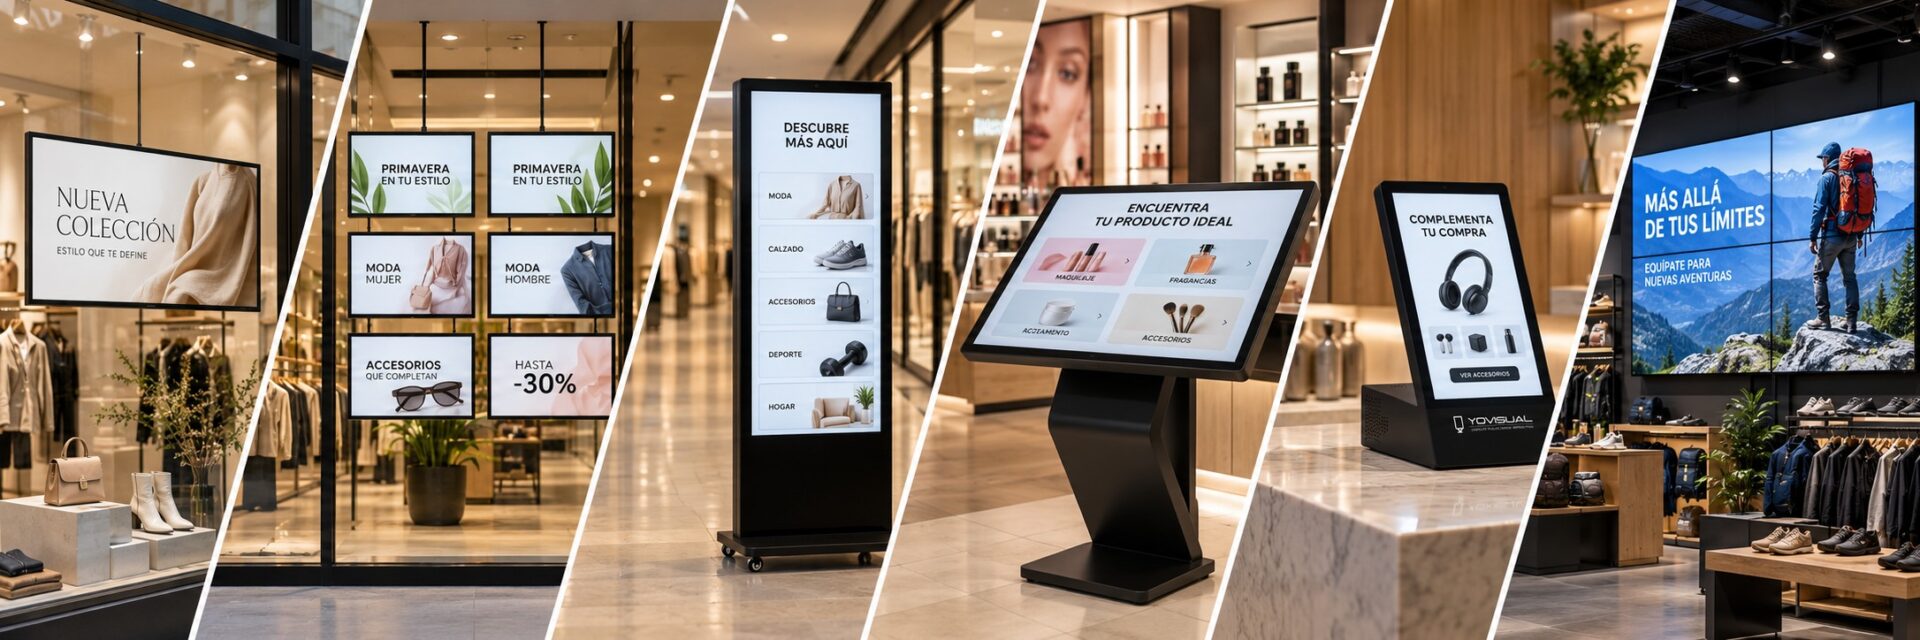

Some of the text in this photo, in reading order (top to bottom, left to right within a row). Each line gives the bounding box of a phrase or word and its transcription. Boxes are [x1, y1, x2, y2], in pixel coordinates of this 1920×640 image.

[783, 122, 850, 134] DESCUBRE
[785, 135, 848, 149] MÁS AQUÍ
[381, 163, 450, 174] PRIMAVERA
[513, 163, 582, 174] PRIMAVERA
[381, 176, 451, 186] EN TU ESTILO
[513, 176, 582, 186] EN TU ESTILO
[57, 186, 129, 213] NUEVA
[768, 192, 792, 200] MODA
[1645, 179, 1722, 213] MÁS ALLÁ
[1126, 202, 1210, 214] ENCUENTRA
[1095, 216, 1233, 227] TU PRODUCTO IDEAL
[1409, 214, 1494, 225] COMPLEMENTA
[1645, 205, 1765, 239] DE TUS LÍMITES
[56, 214, 175, 243] COLECCIÓN
[1421, 227, 1487, 238] TU COMPRA
[56, 246, 148, 260] ESTILO QUE TE DEFINE
[768, 245, 804, 253] CALZADO
[365, 263, 401, 273] MODA
[505, 263, 540, 273] MODA
[1645, 257, 1711, 274] EQUÍPATE PARA
[365, 274, 402, 285] MUJER
[505, 274, 551, 285] HOMBRE
[1168, 277, 1217, 285] FRAGANCIAS
[1645, 270, 1732, 287] NUEVAS AVENTURAS
[768, 298, 816, 306] ACCESORIOS
[1141, 334, 1192, 344] ACCESORIOS
[365, 360, 442, 370] ACCESORIOS
[515, 359, 554, 370] HASTA
[365, 372, 438, 381] QUE COMPLETAN
[1473, 371, 1511, 379] ACCESORIOS
[513, 373, 577, 394] -30%
[768, 403, 796, 411] HOGAR
[1467, 414, 1534, 425] YOVISUAL
